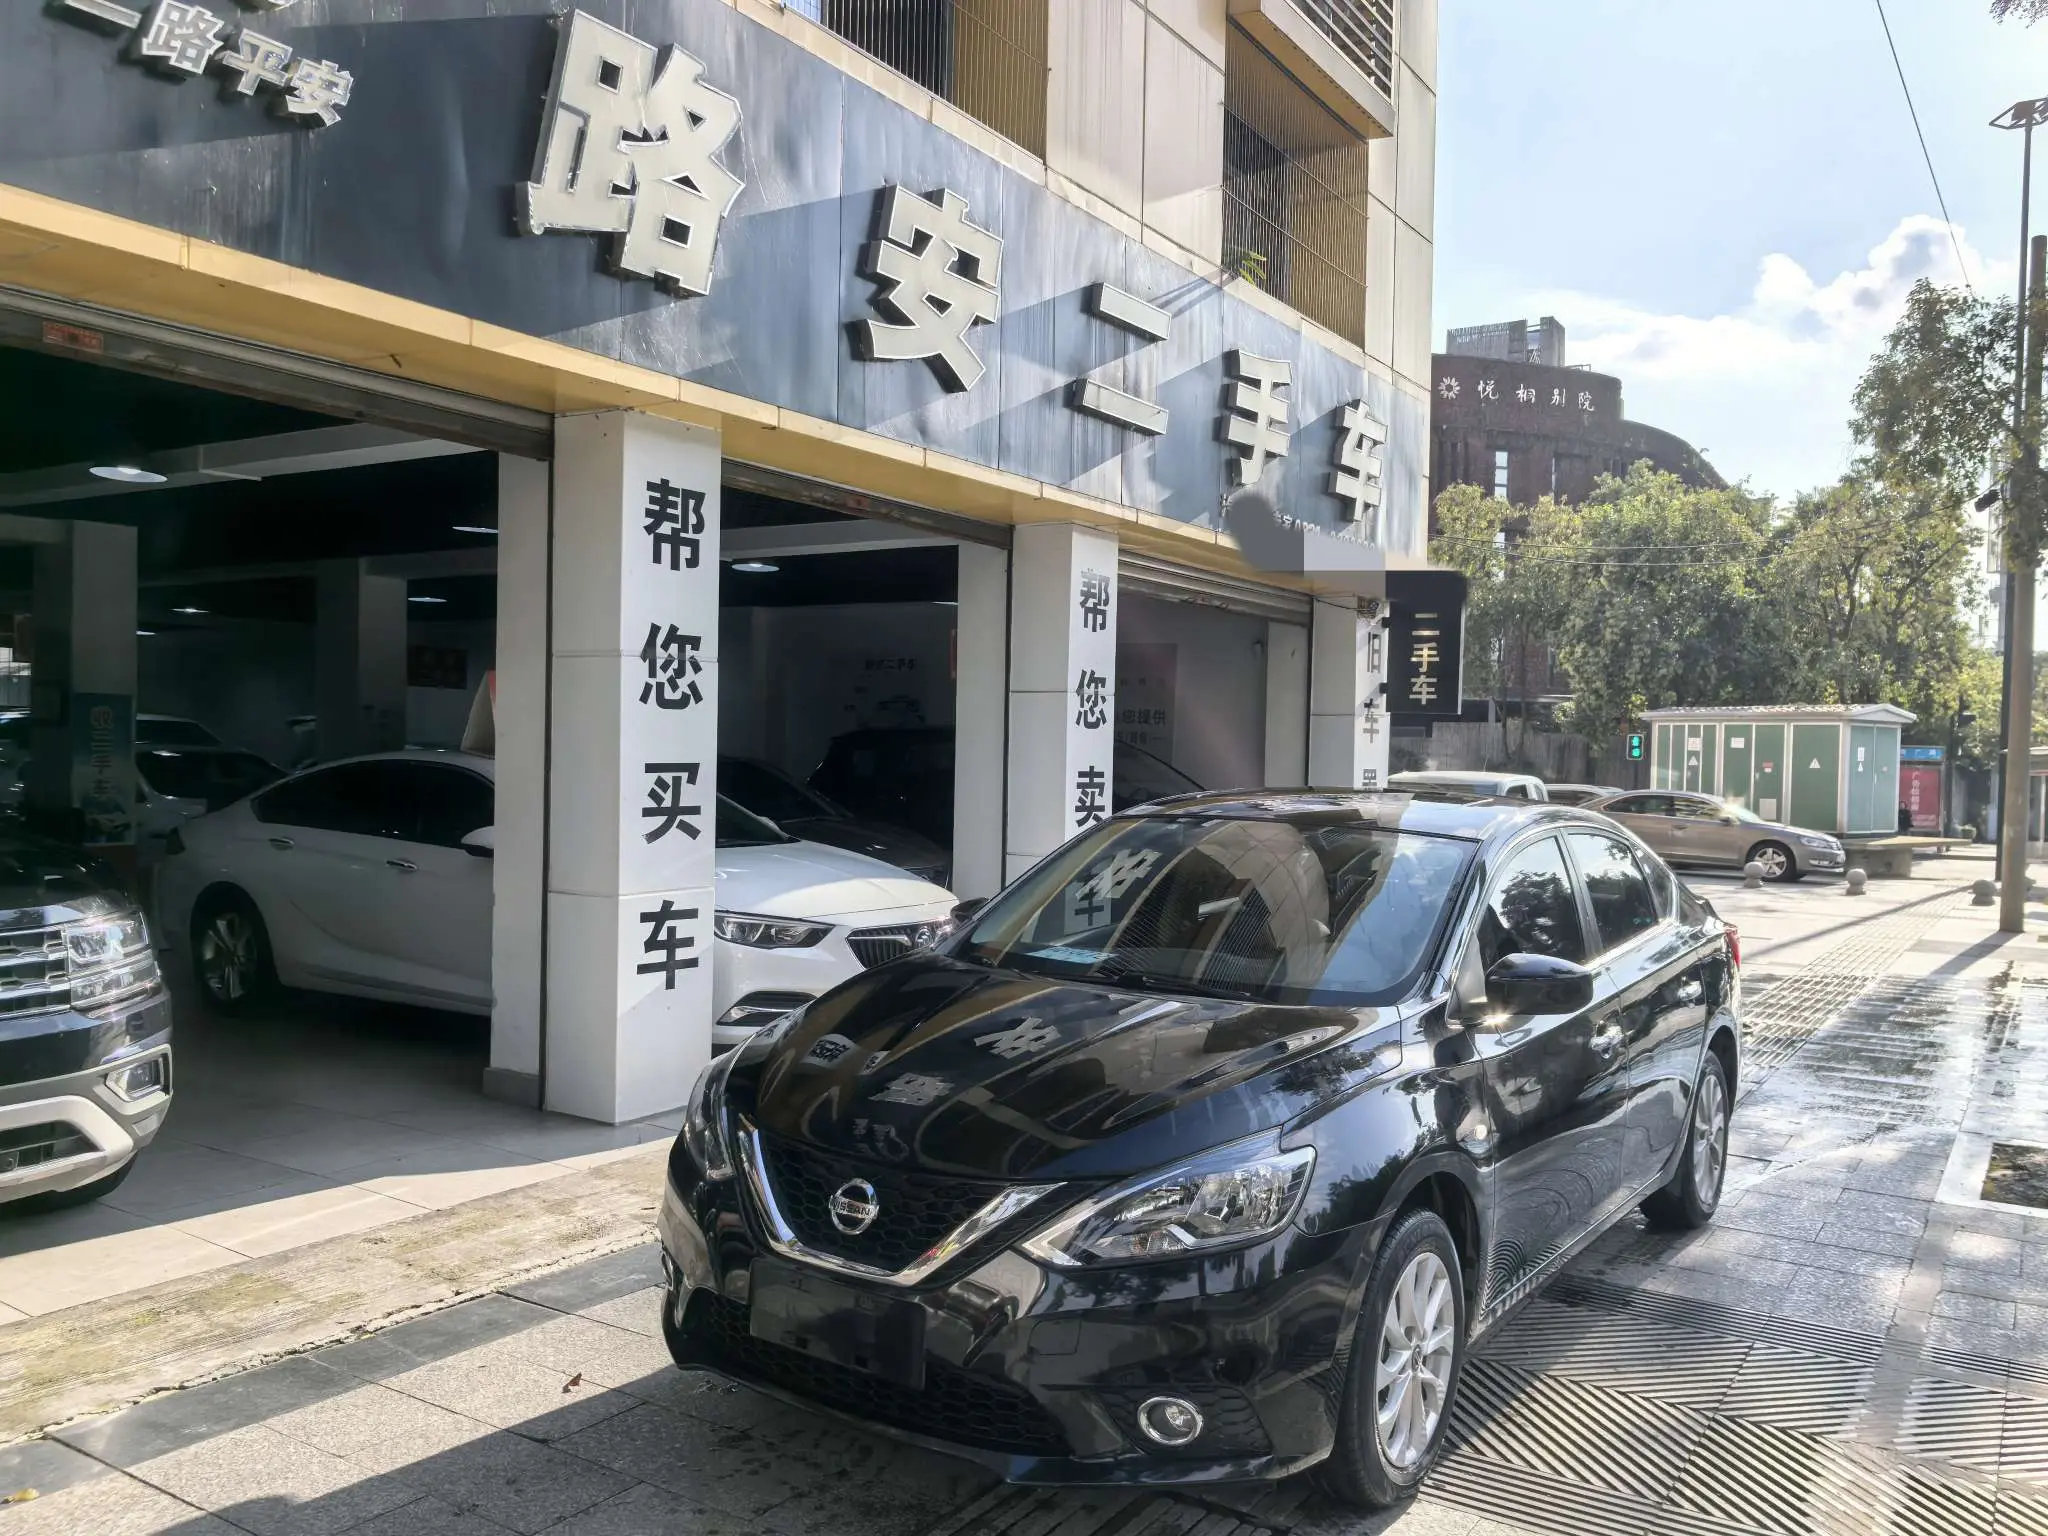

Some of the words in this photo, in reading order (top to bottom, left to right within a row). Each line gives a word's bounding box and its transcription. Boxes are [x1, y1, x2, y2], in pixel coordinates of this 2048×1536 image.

[62, 0, 354, 126] 一路平安
[524, 7, 1388, 523] 路安二手车
[1409, 613, 1440, 705] 二手车
[637, 477, 707, 990] 帮您买车
[830, 1195, 872, 1217] NISSAN
